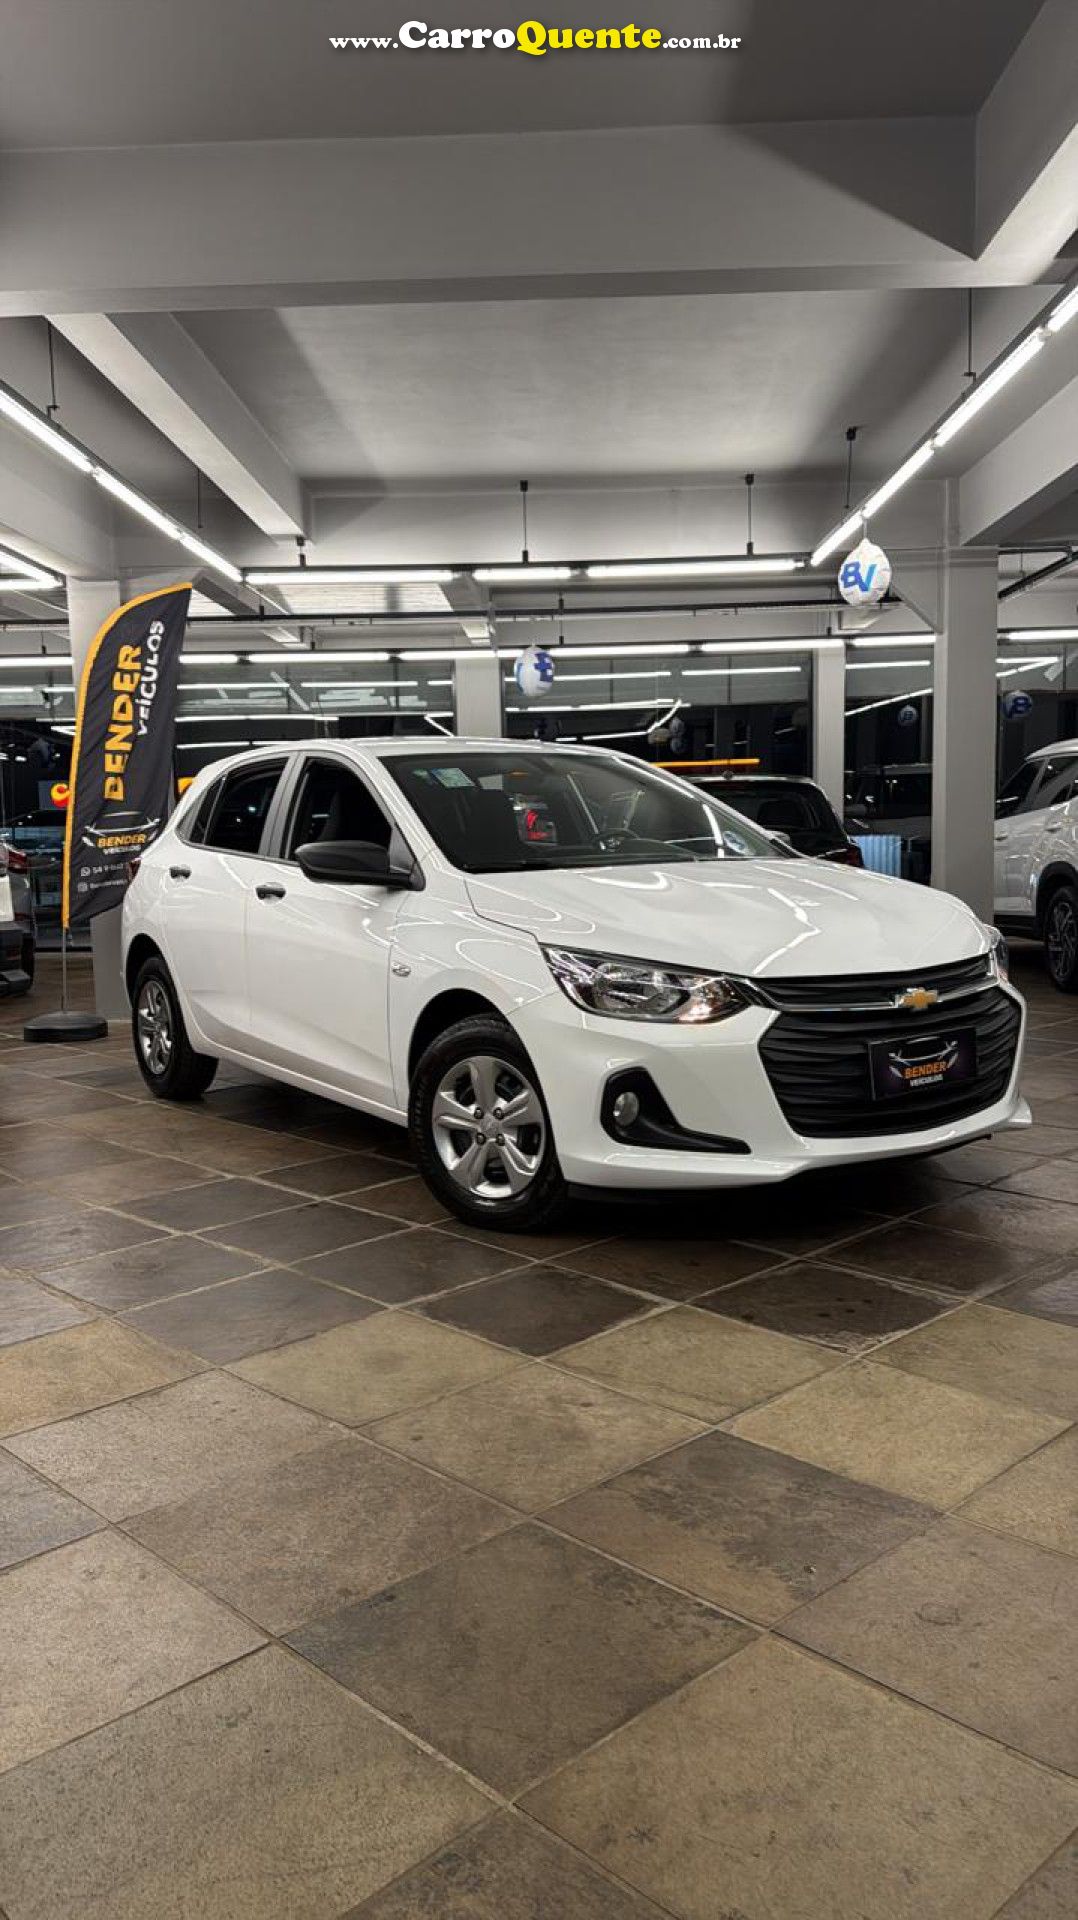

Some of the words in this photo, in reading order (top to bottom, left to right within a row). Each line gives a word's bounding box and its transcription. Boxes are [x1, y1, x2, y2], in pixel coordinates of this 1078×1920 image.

[841, 561, 877, 591] BV
[104, 645, 141, 801] BENDER
[96, 834, 146, 848] BENDER
[904, 1061, 947, 1079] BENDER
